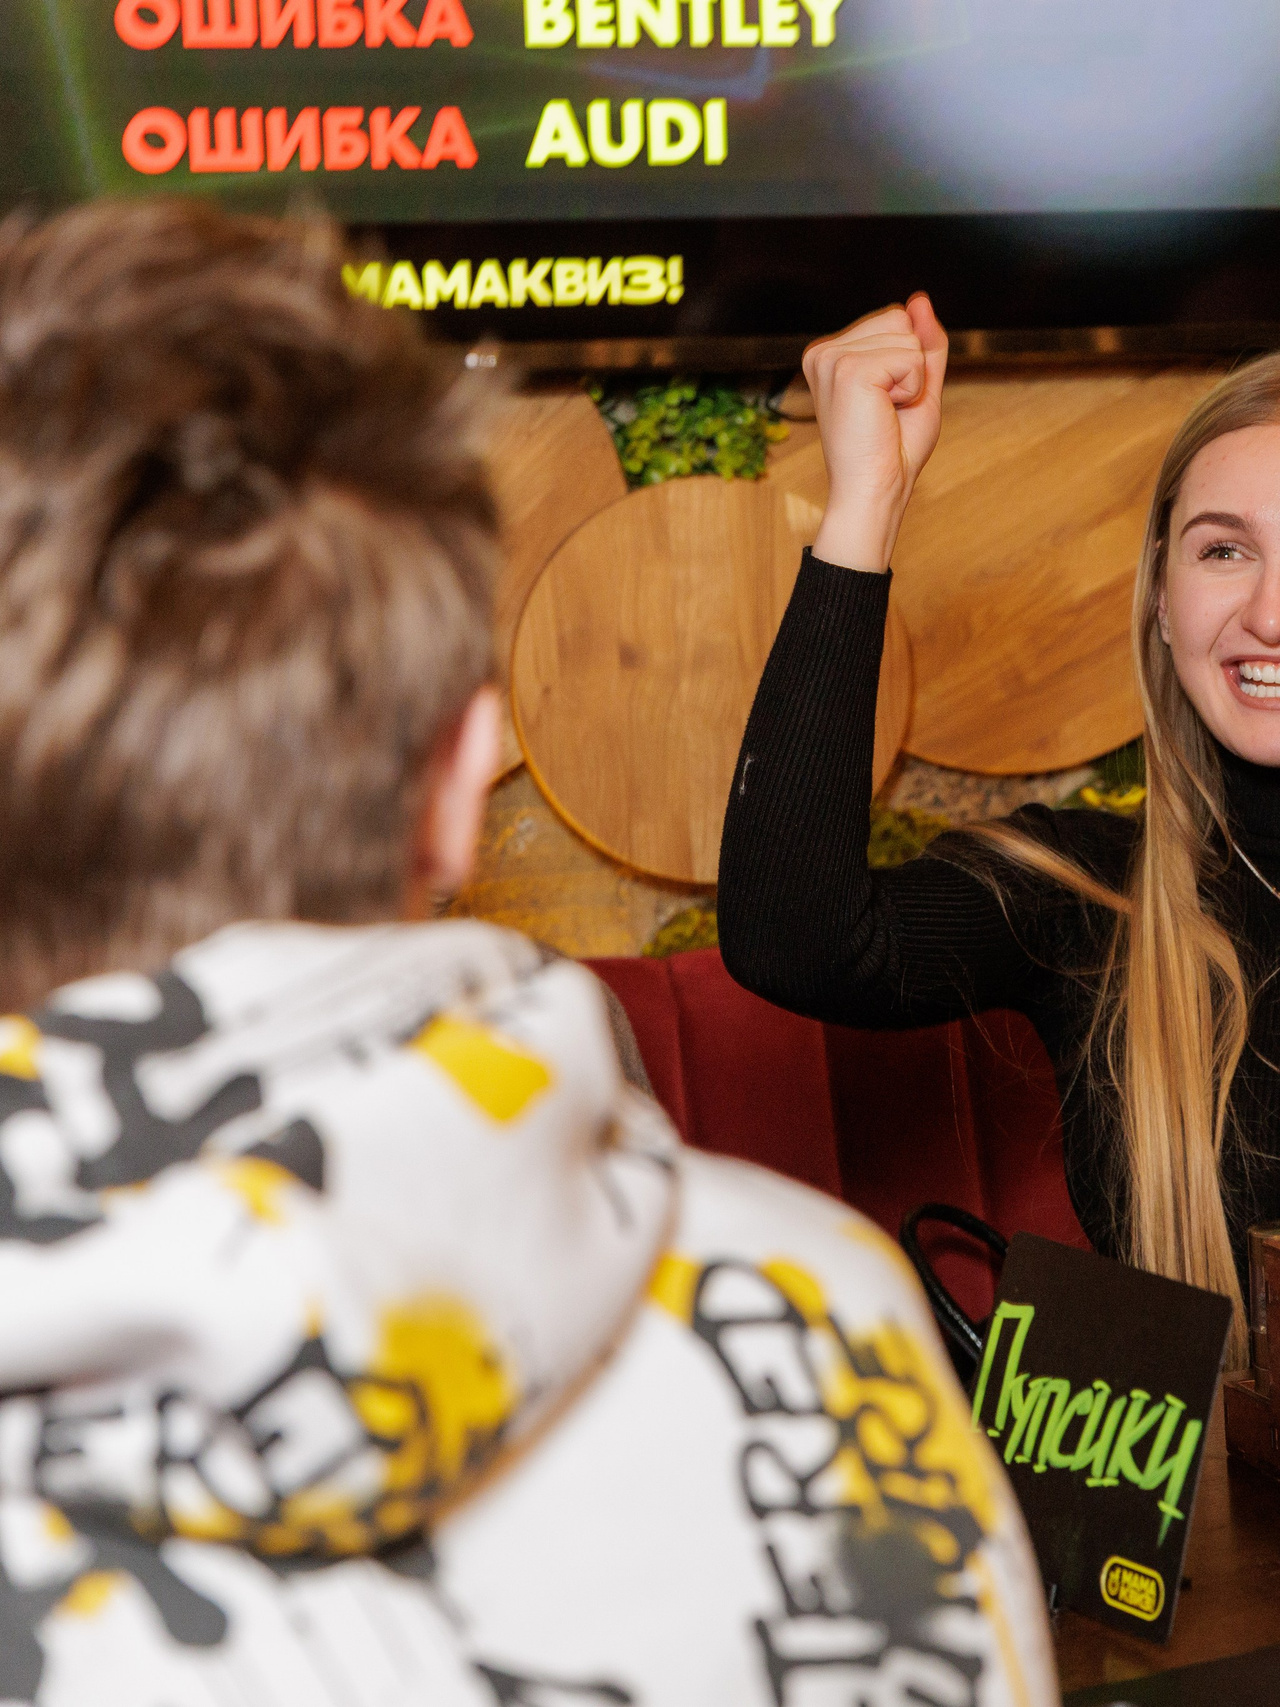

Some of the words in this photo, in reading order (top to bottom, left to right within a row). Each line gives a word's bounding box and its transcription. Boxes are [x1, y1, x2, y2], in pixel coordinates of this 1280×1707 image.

[114, 0, 474, 50] ОШИБКА
[523, 0, 844, 48] BENTLEY
[121, 106, 479, 174] ОШИБКА
[525, 98, 729, 168] AUDI
